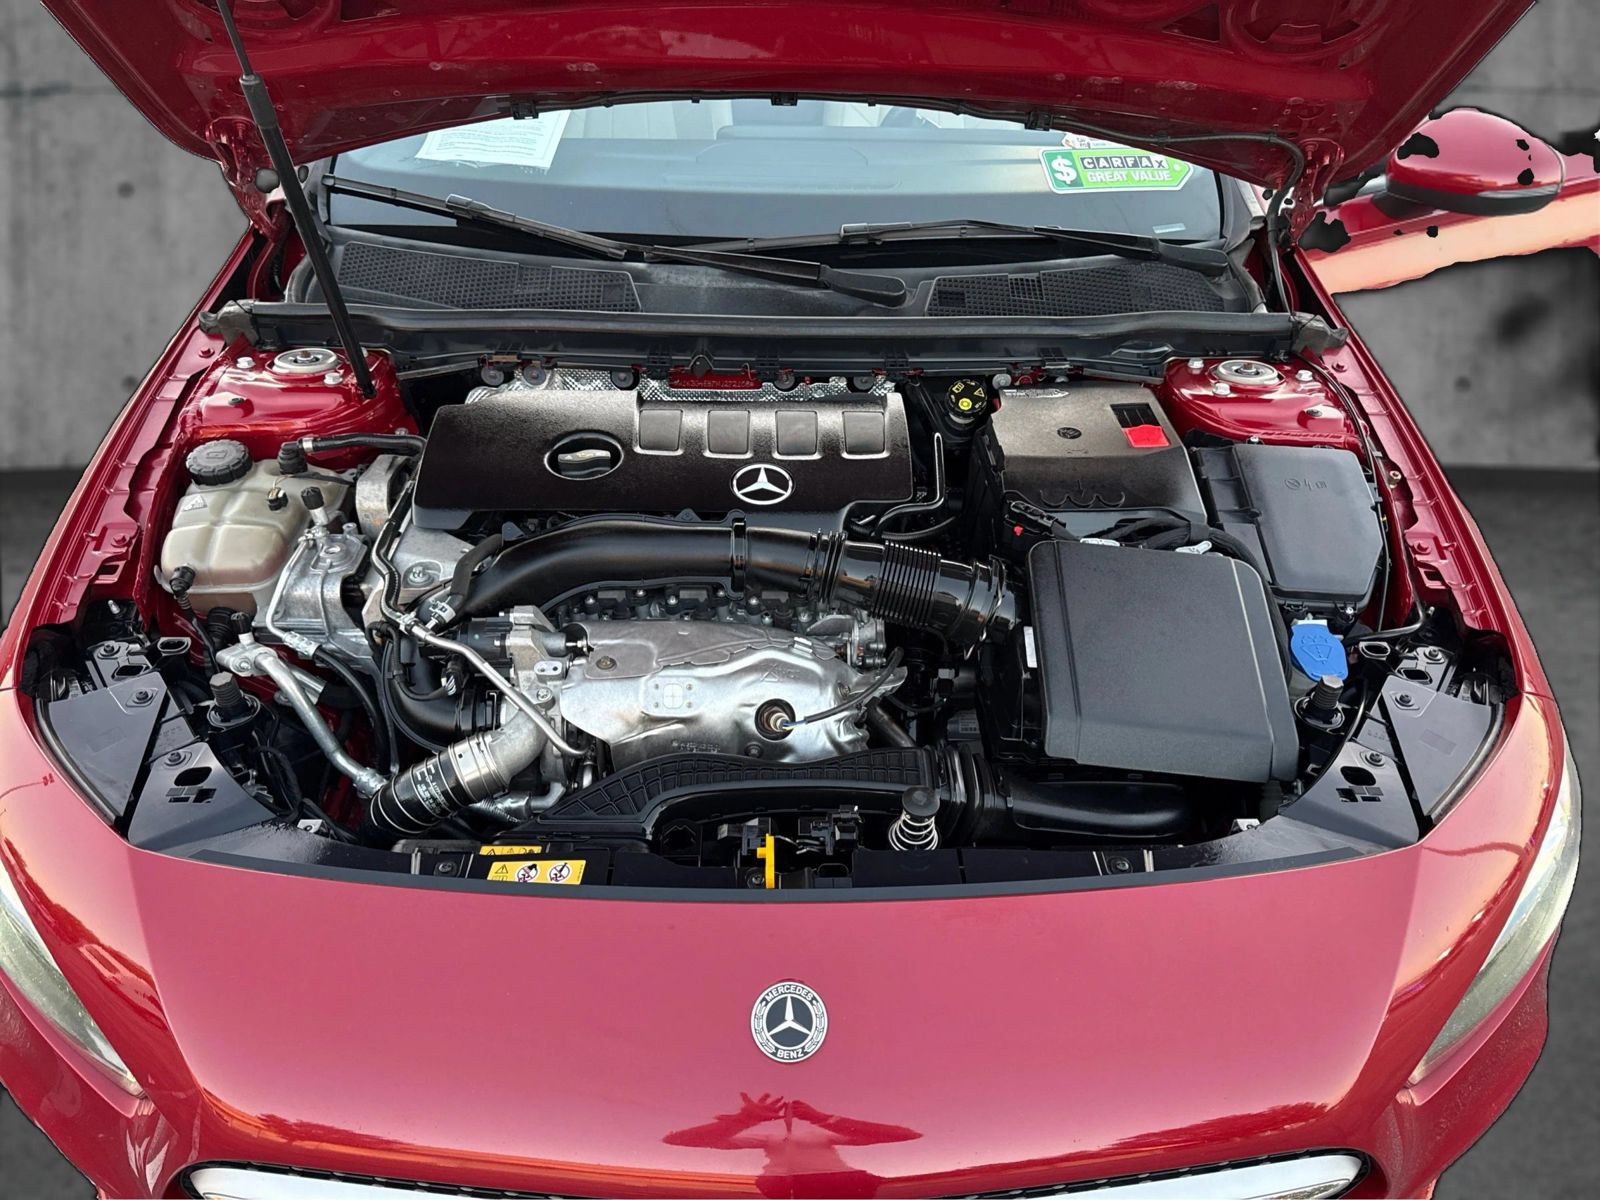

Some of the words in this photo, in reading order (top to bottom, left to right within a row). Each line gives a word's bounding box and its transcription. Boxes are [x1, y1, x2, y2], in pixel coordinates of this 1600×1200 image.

[1081, 155, 1168, 169] CARFAX
[1088, 171, 1128, 182] GREAT
[1132, 170, 1172, 181] VALUE
[765, 985, 814, 1001] MERCEDES
[776, 1048, 804, 1059] BENZ
